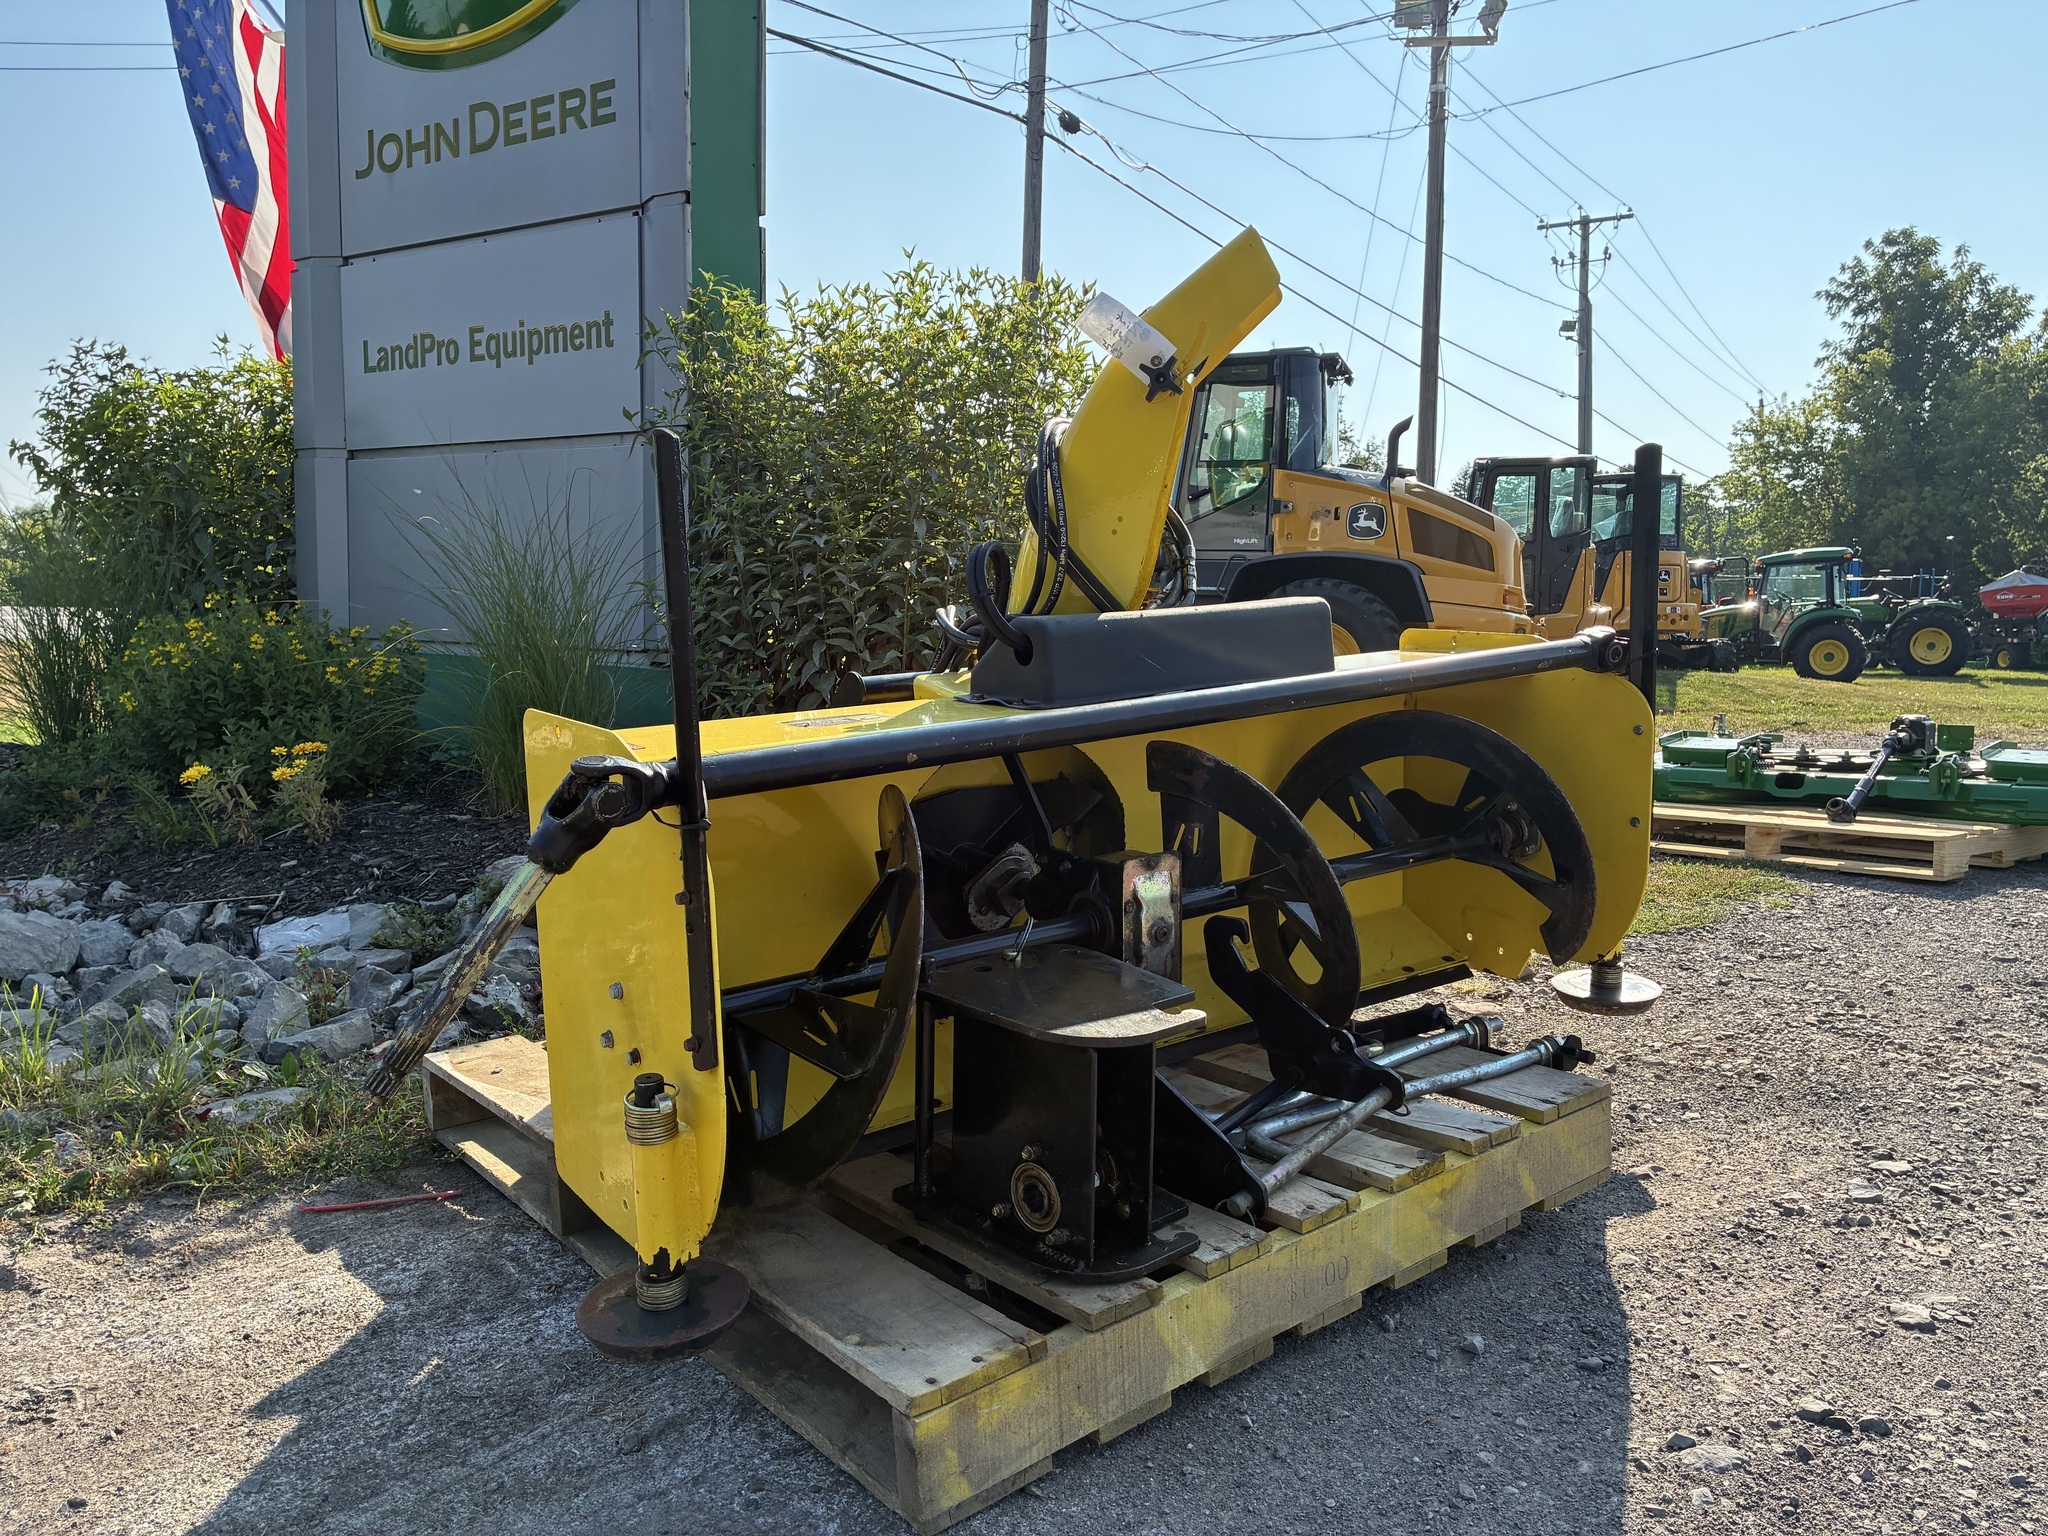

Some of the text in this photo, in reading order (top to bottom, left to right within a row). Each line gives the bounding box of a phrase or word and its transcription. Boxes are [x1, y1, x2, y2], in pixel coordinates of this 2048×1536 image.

[355, 78, 617, 179] JOHN DEERE
[363, 309, 614, 374] LandPro Equipment
